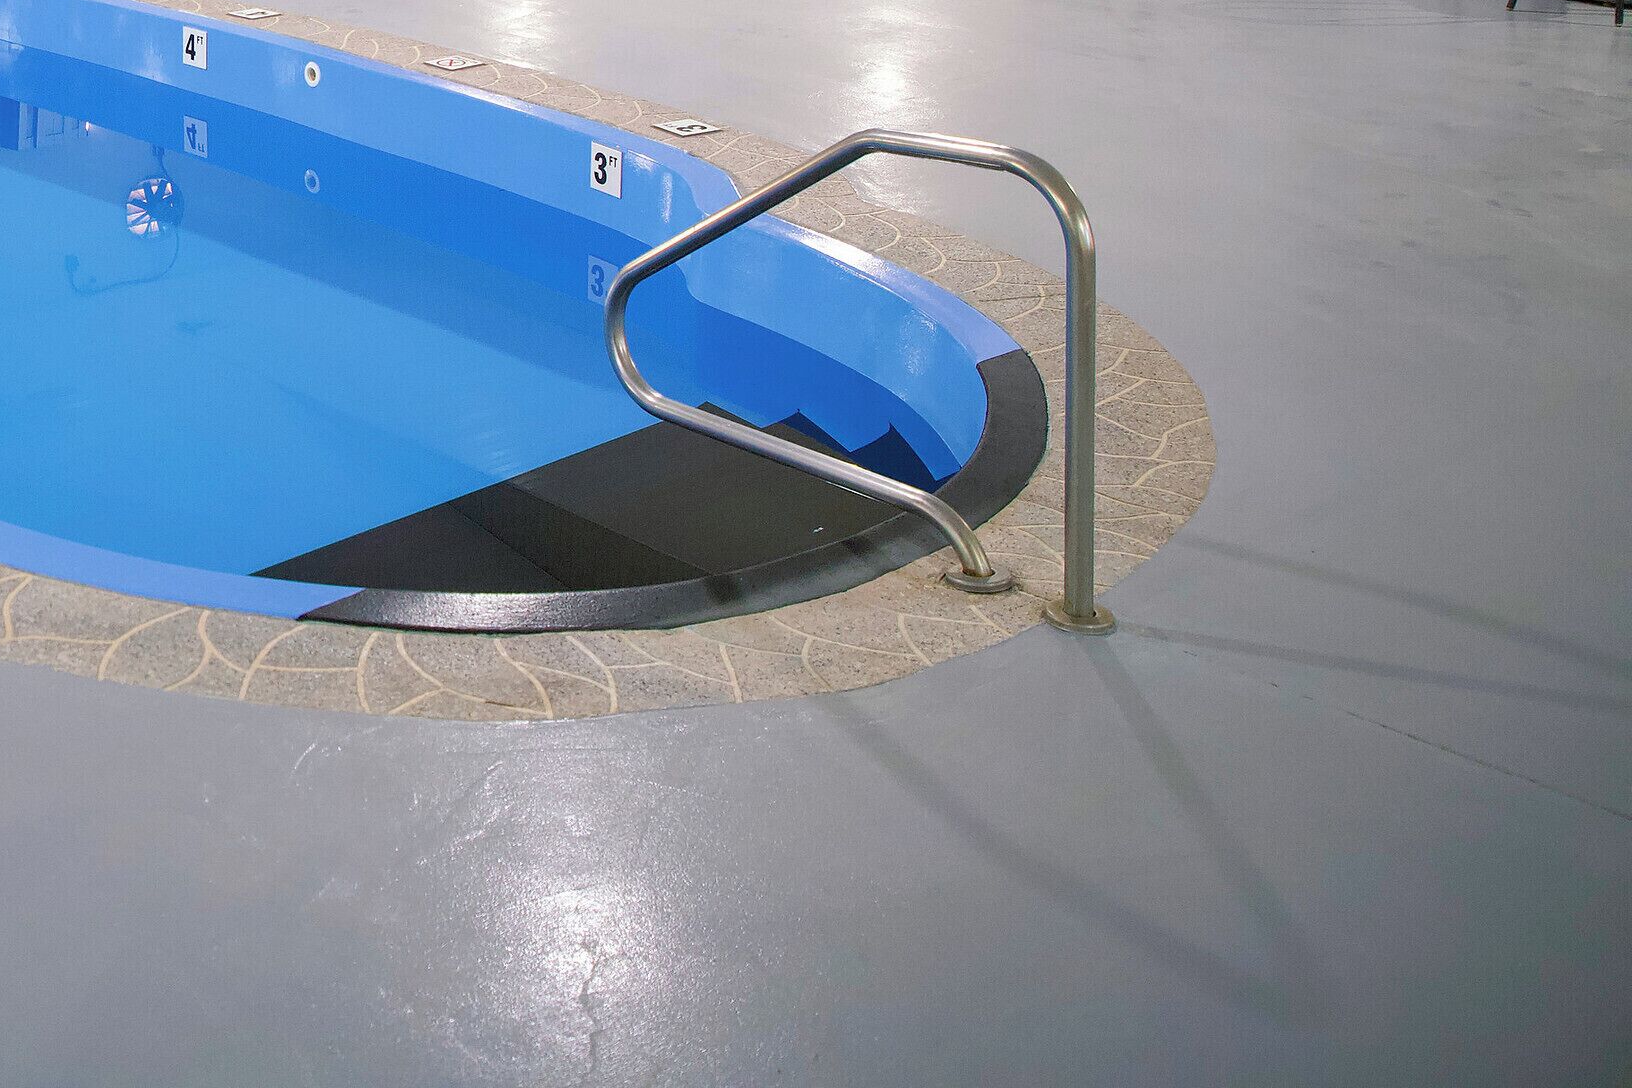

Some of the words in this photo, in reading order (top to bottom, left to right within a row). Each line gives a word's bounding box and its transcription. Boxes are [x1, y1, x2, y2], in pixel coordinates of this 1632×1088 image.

[185, 34, 196, 60] 4
[197, 36, 203, 45] FT
[594, 152, 607, 184] 3
[609, 156, 618, 168] FT
